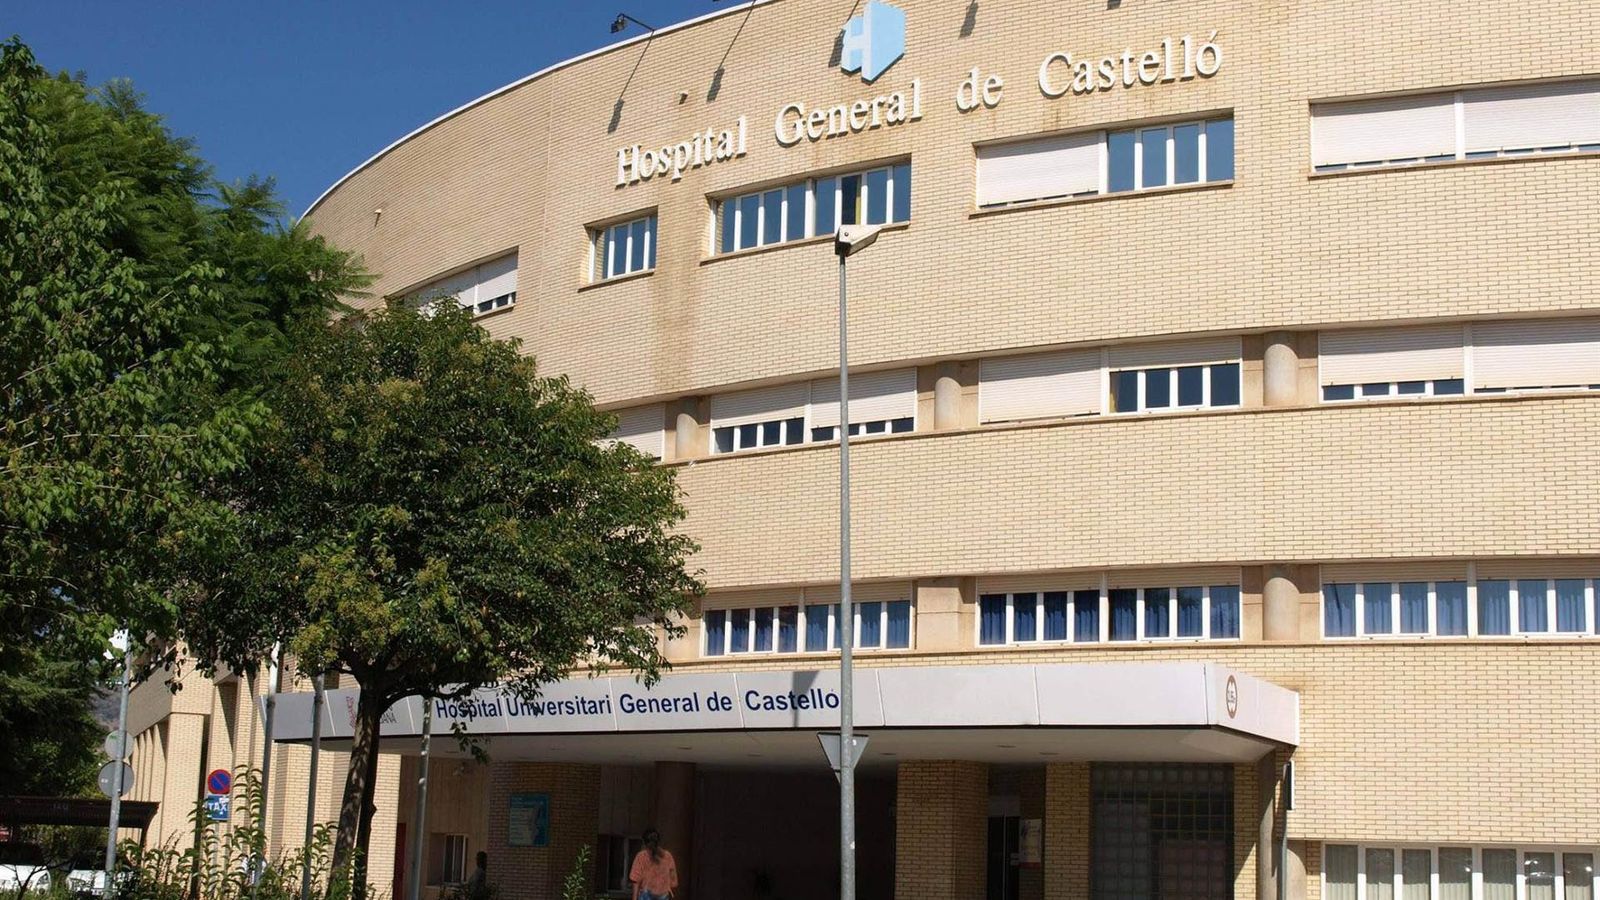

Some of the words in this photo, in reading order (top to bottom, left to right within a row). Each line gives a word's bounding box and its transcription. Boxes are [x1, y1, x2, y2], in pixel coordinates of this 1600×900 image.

[616, 115, 747, 187] Hospital
[775, 78, 922, 146] General
[956, 66, 1003, 112] de
[1038, 29, 1222, 98] Castelló
[435, 698, 502, 722] Hospital
[506, 695, 612, 717] Universitari
[619, 692, 700, 714] General
[706, 691, 733, 712] de
